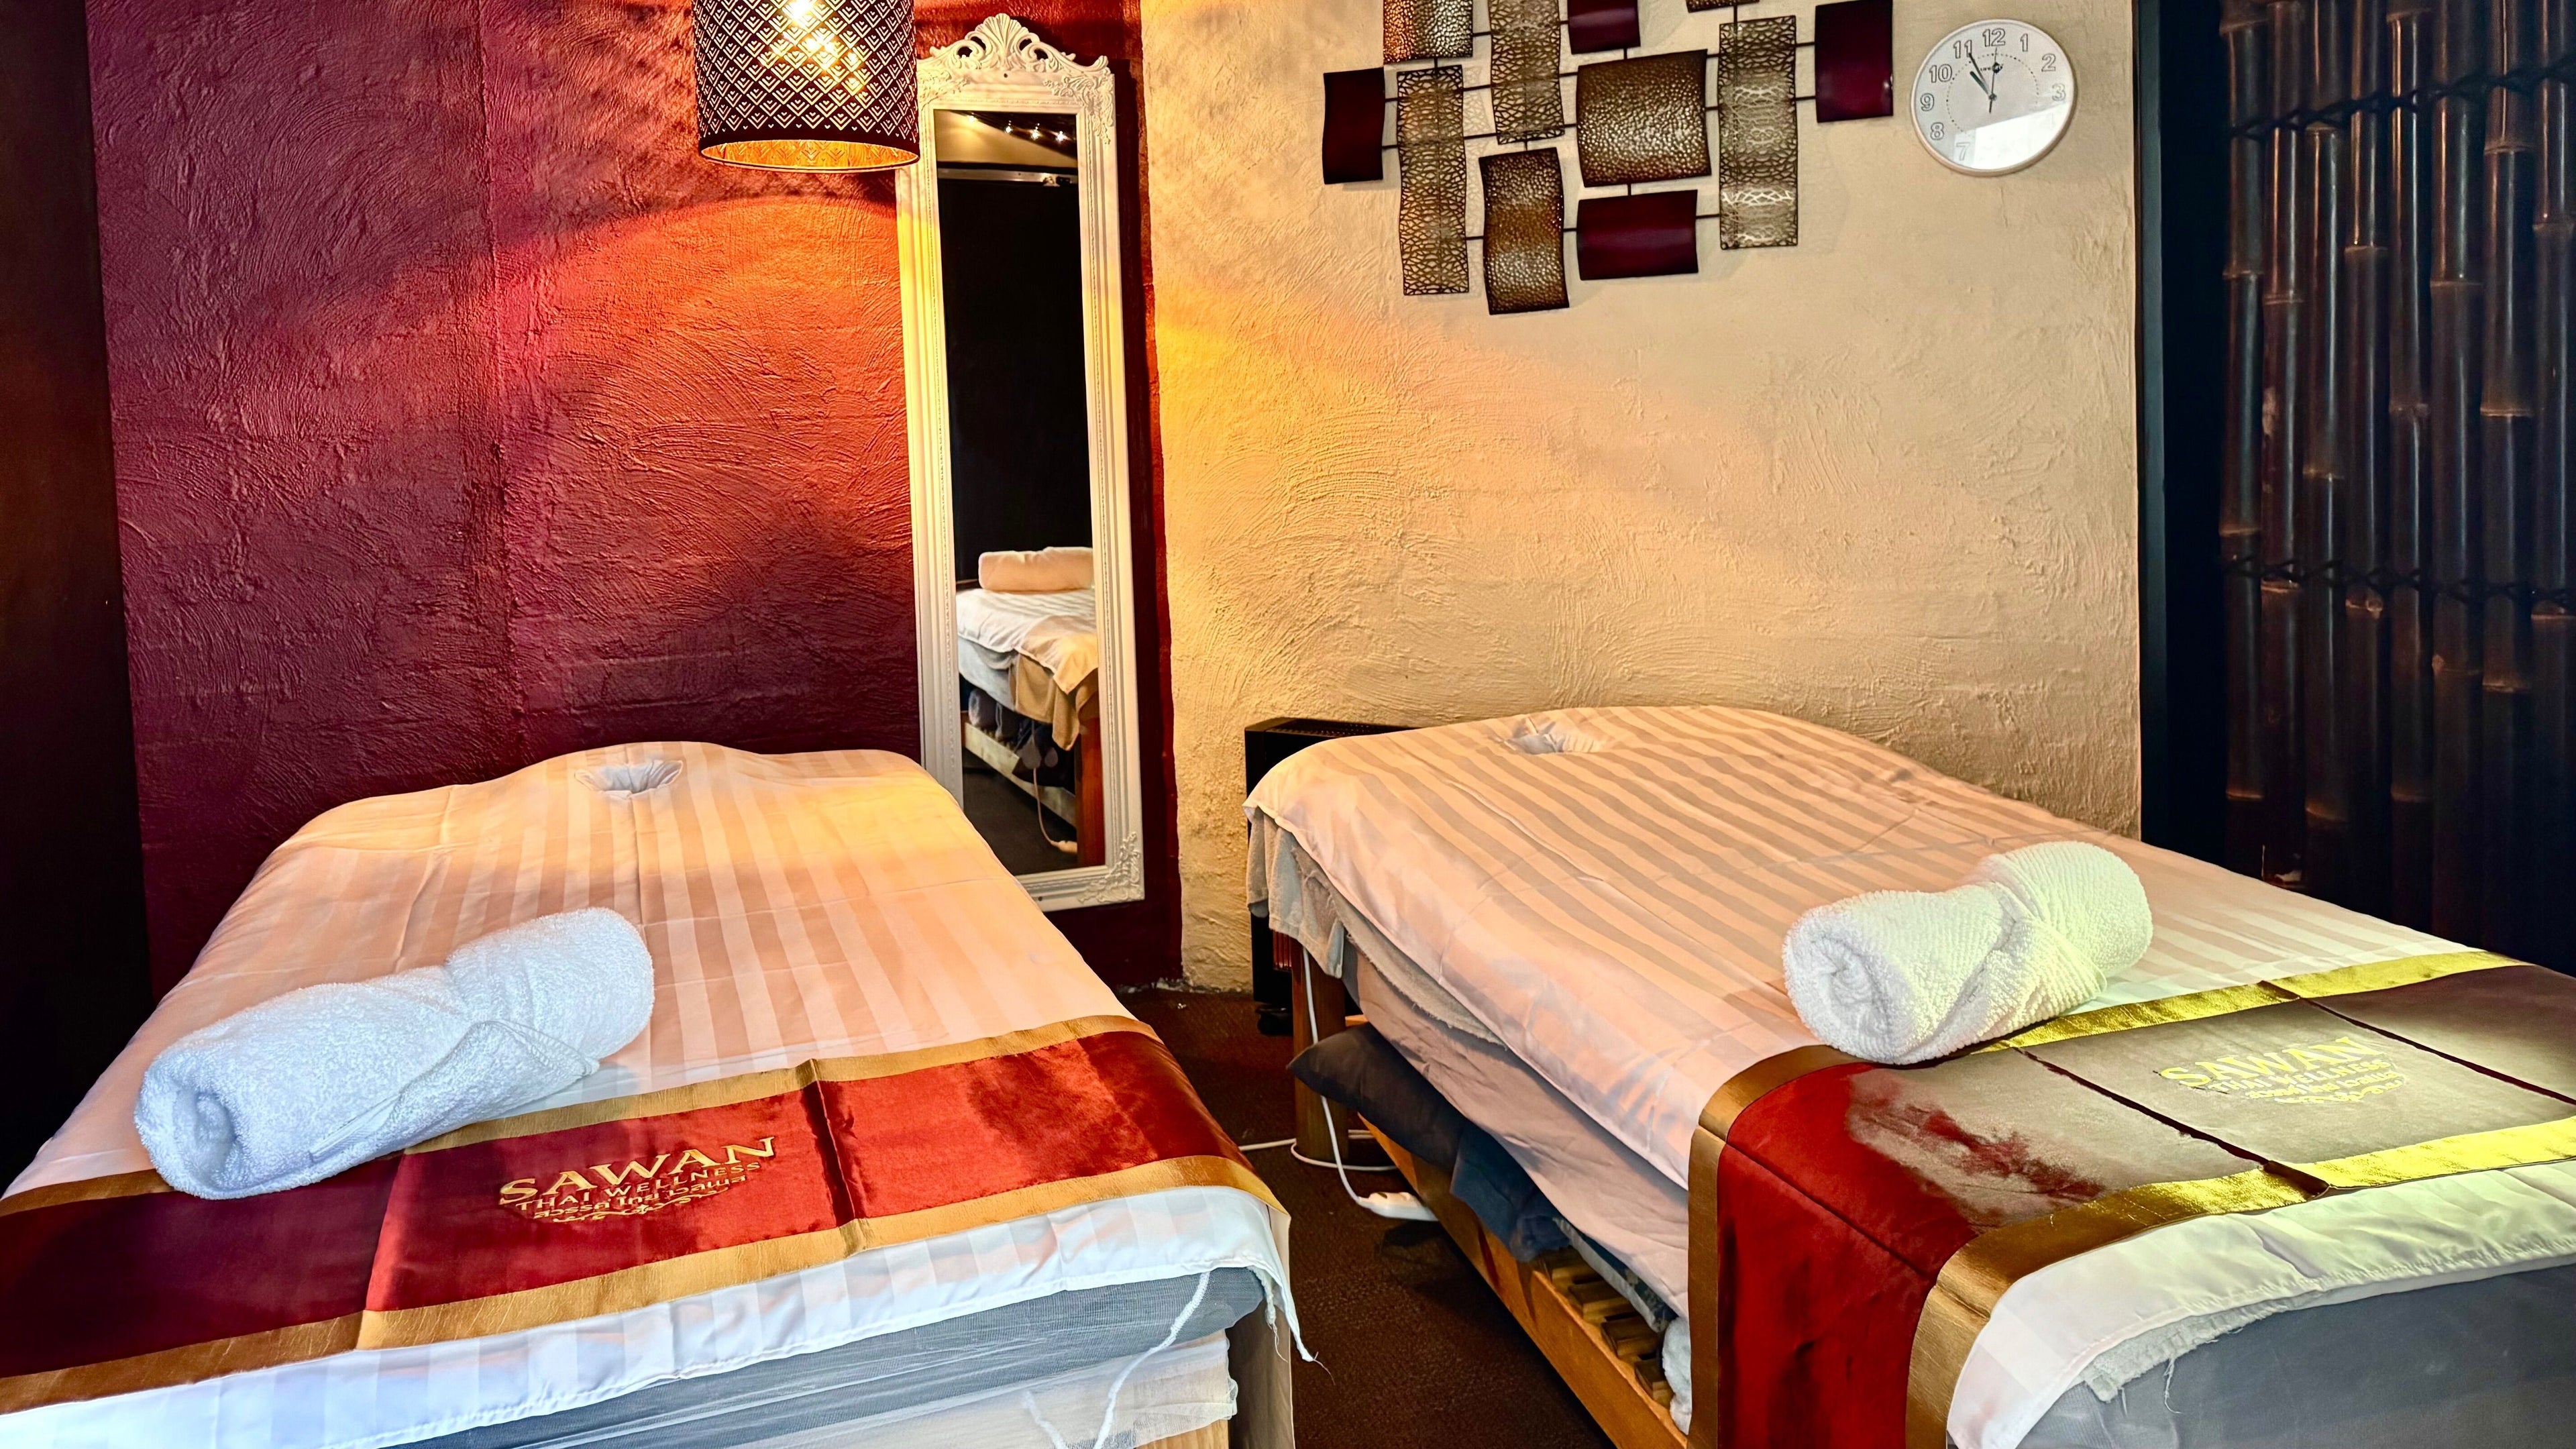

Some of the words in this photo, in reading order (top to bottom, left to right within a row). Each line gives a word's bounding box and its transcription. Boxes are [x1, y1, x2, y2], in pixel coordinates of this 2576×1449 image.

[1982, 28, 2005, 46] 12
[2021, 34, 2029, 52] 1
[1953, 40, 1972, 58] 11
[2041, 54, 2056, 72] 2
[1929, 64, 1952, 83] 10
[2051, 83, 2065, 101] 3
[1921, 93, 1935, 111] 9
[1930, 122, 1944, 140] 8
[1956, 142, 1970, 160] 7
[2161, 1036, 2385, 1087] SAWAN
[2208, 1078, 2272, 1091] THAI
[499, 1136, 775, 1205] SAWAN
[516, 1191, 590, 1211] THAI
[604, 1162, 761, 1197] WELLNESS
